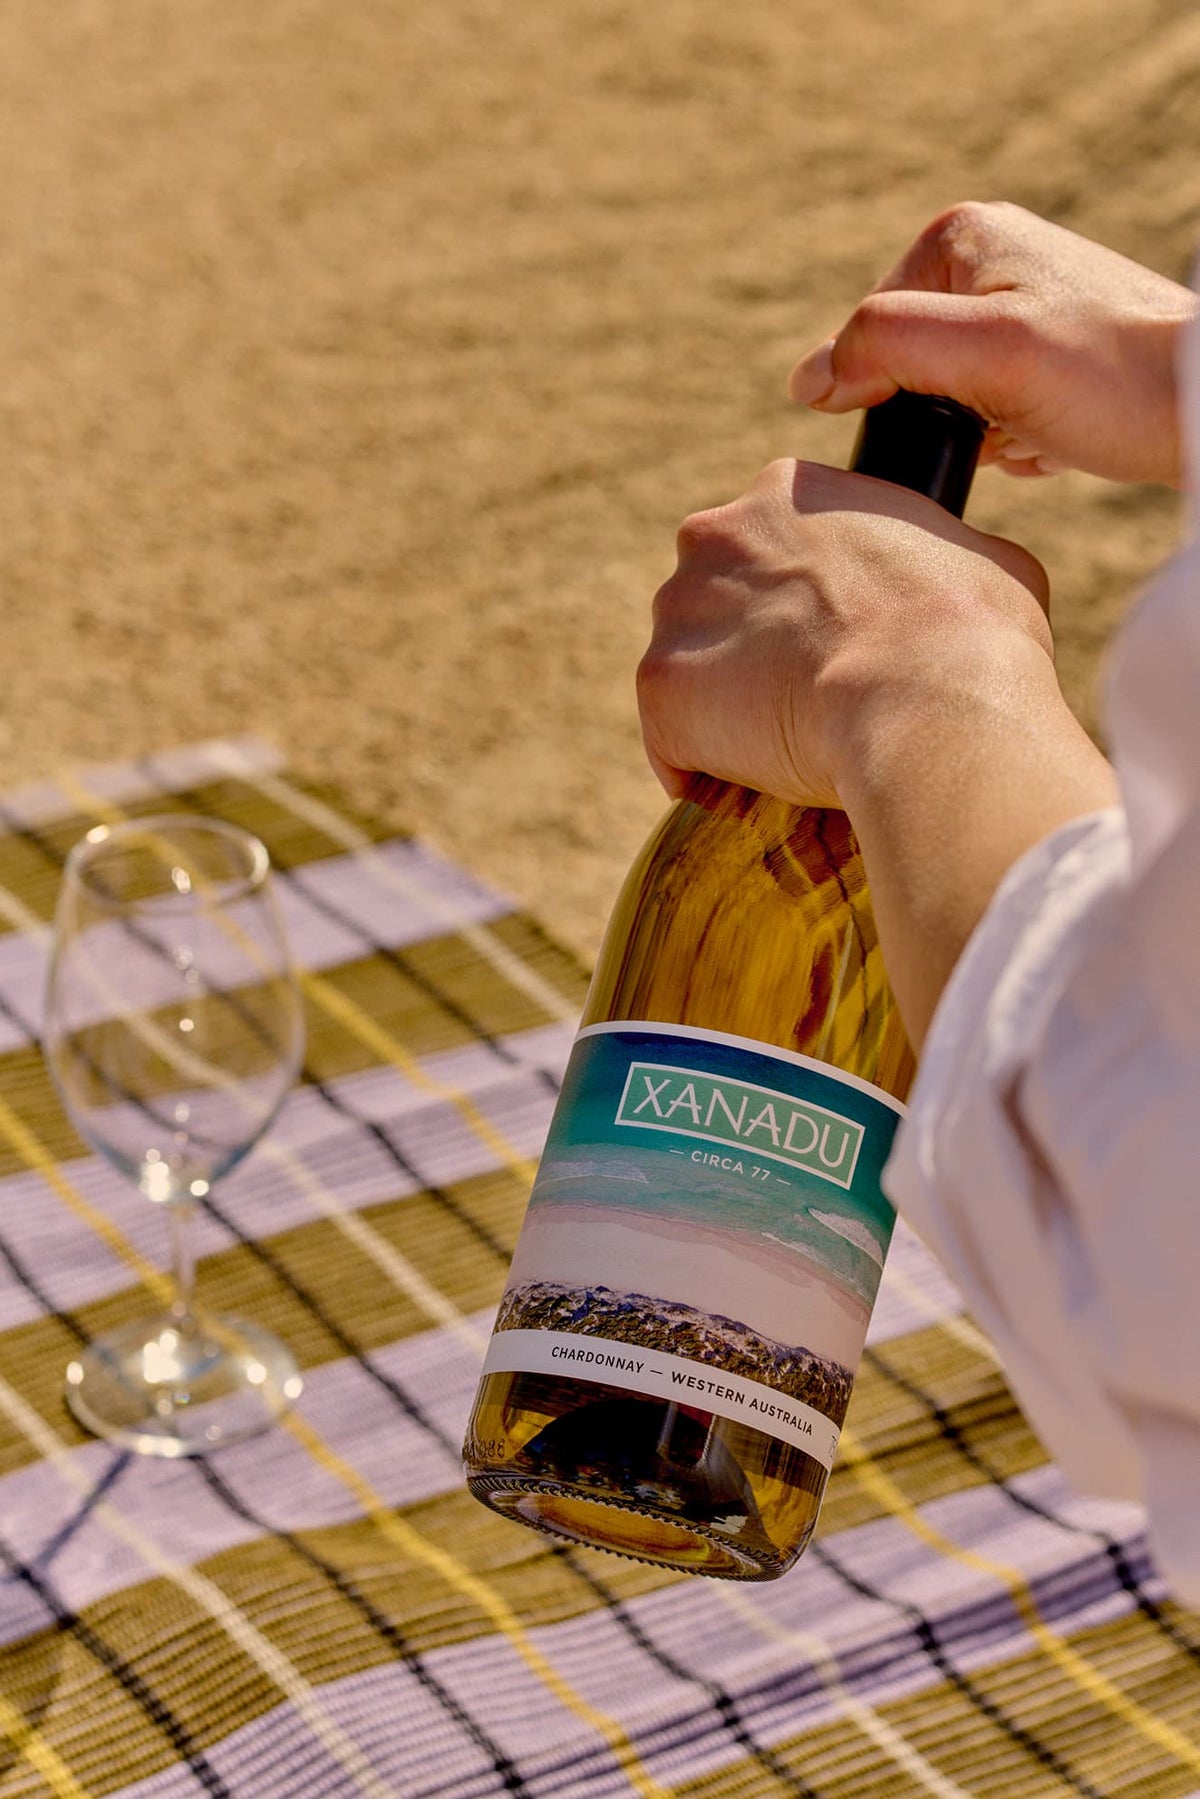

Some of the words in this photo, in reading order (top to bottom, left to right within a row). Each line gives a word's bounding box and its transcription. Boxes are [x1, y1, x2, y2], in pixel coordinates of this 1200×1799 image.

[632, 1075, 850, 1168] XANADU
[691, 1150, 743, 1174] CIRCA
[751, 1166, 771, 1181] 77
[551, 1346, 645, 1373] CHARDONNAY
[671, 1371, 745, 1404] WESTERN
[749, 1398, 812, 1436] AUSTRALIA
